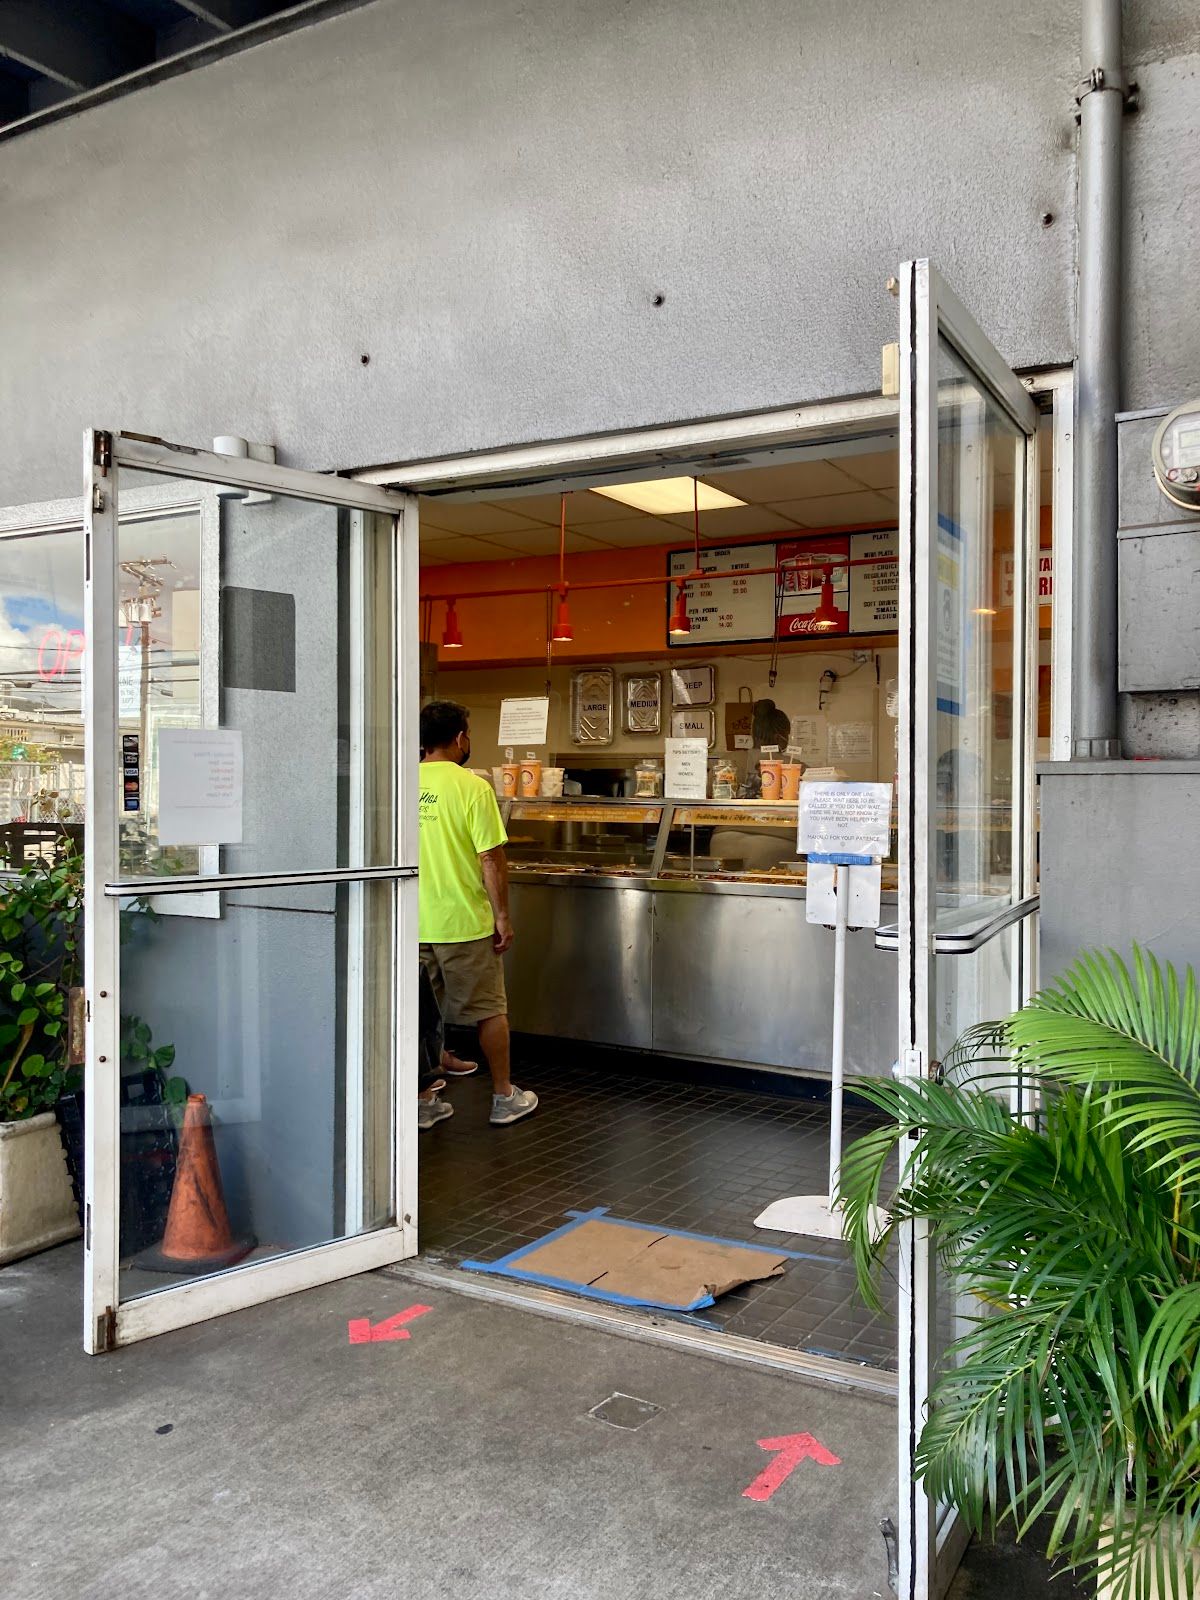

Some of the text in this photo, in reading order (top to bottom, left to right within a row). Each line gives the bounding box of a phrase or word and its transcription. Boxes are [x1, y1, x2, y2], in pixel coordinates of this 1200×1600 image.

[684, 682, 703, 690] DEEP
[583, 703, 607, 712] LARGE
[630, 700, 658, 708] MEDIUM
[680, 722, 704, 730] SMALL
